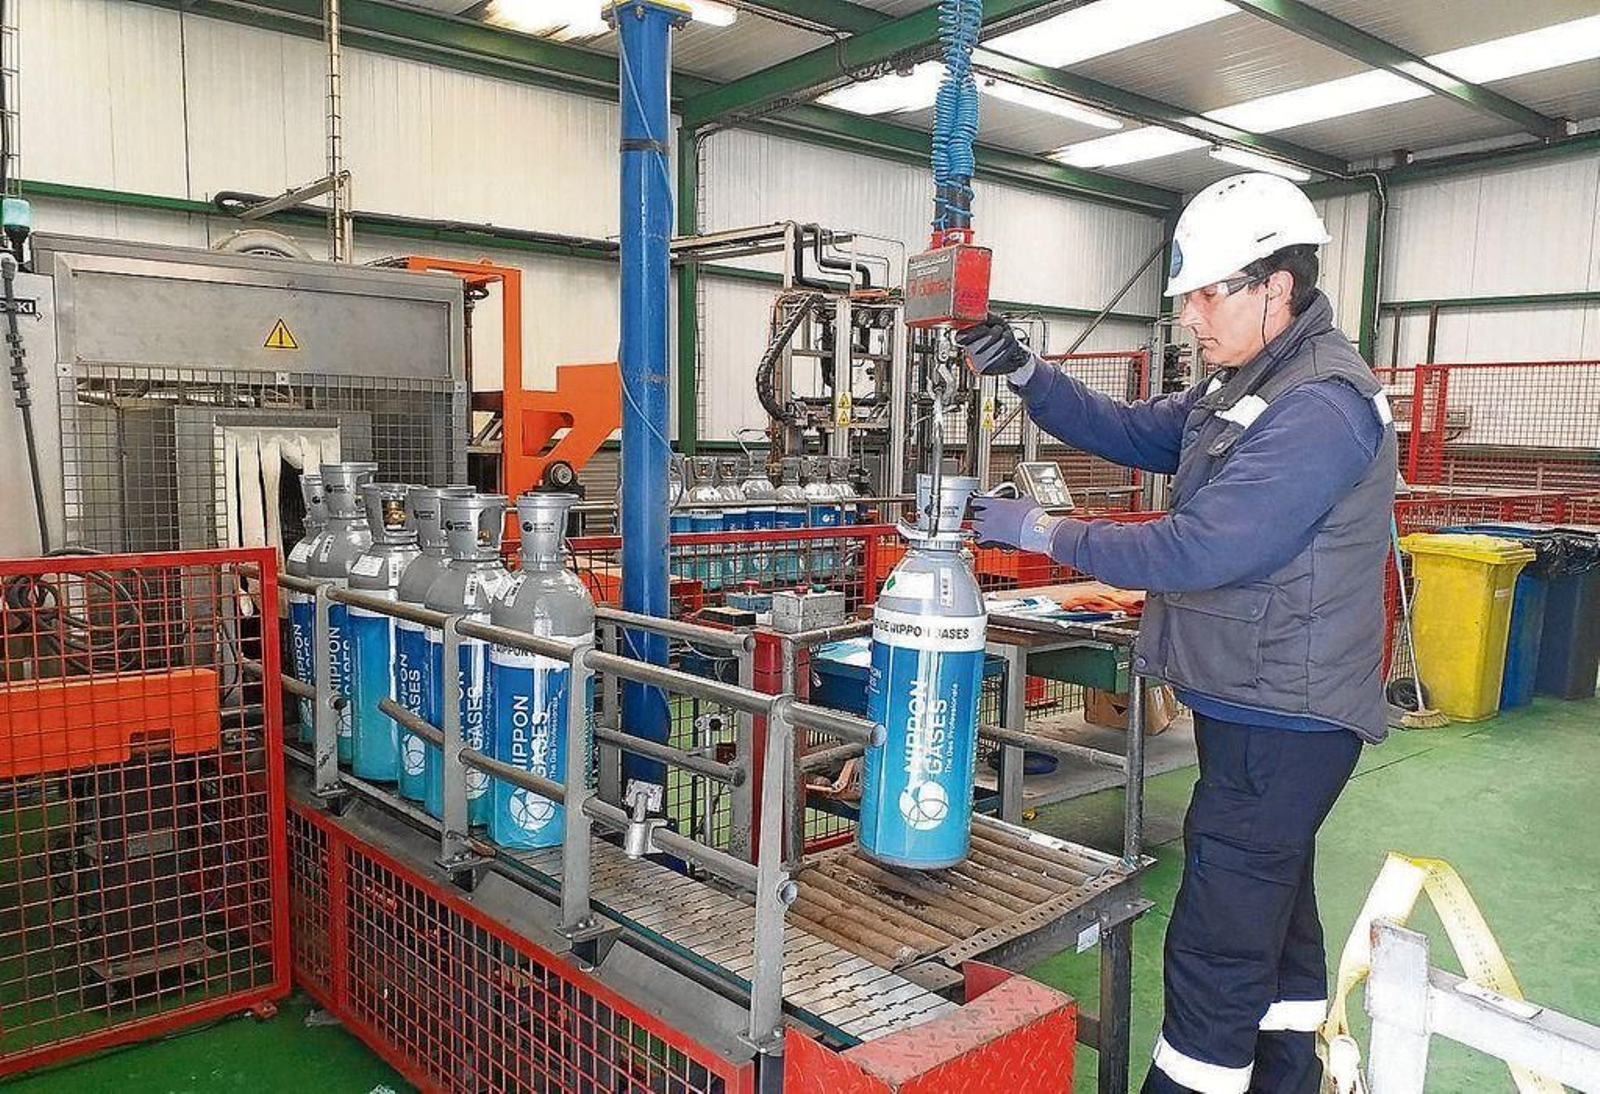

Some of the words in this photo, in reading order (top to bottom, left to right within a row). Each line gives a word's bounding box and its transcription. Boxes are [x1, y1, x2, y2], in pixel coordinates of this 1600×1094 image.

[935, 628, 970, 640] ASES
[408, 669, 421, 718] ASES
[530, 711, 548, 778] GASES
[925, 699, 946, 775] GASES
